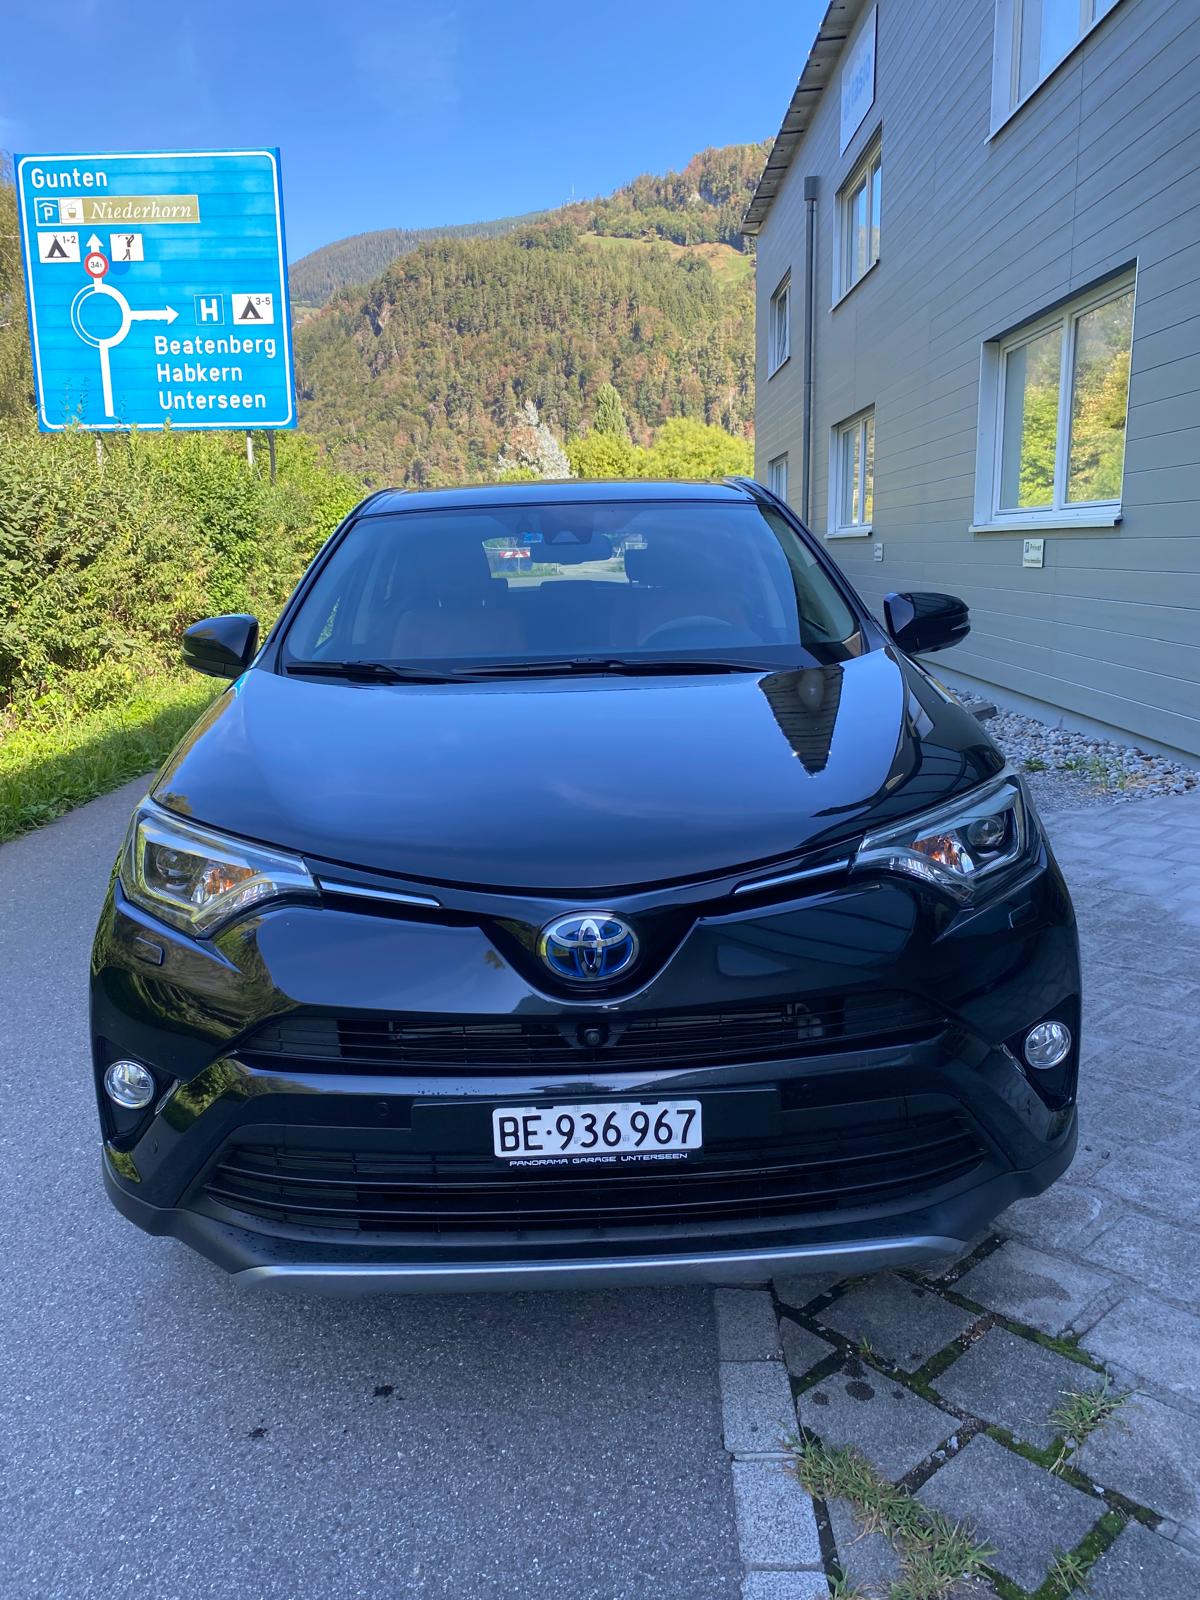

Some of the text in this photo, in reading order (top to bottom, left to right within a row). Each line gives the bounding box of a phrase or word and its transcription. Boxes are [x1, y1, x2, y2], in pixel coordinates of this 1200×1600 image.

[31, 168, 108, 188] Gunten
[91, 201, 192, 220] Niederhorn
[200, 298, 219, 322] H
[255, 296, 271, 306] 3-5
[154, 334, 276, 359] Beatenberg
[157, 363, 243, 383] Habkern
[158, 390, 267, 410] Unterseen
[509, 1153, 688, 1167] PANORAMA GARAGE UNTERSEEN
